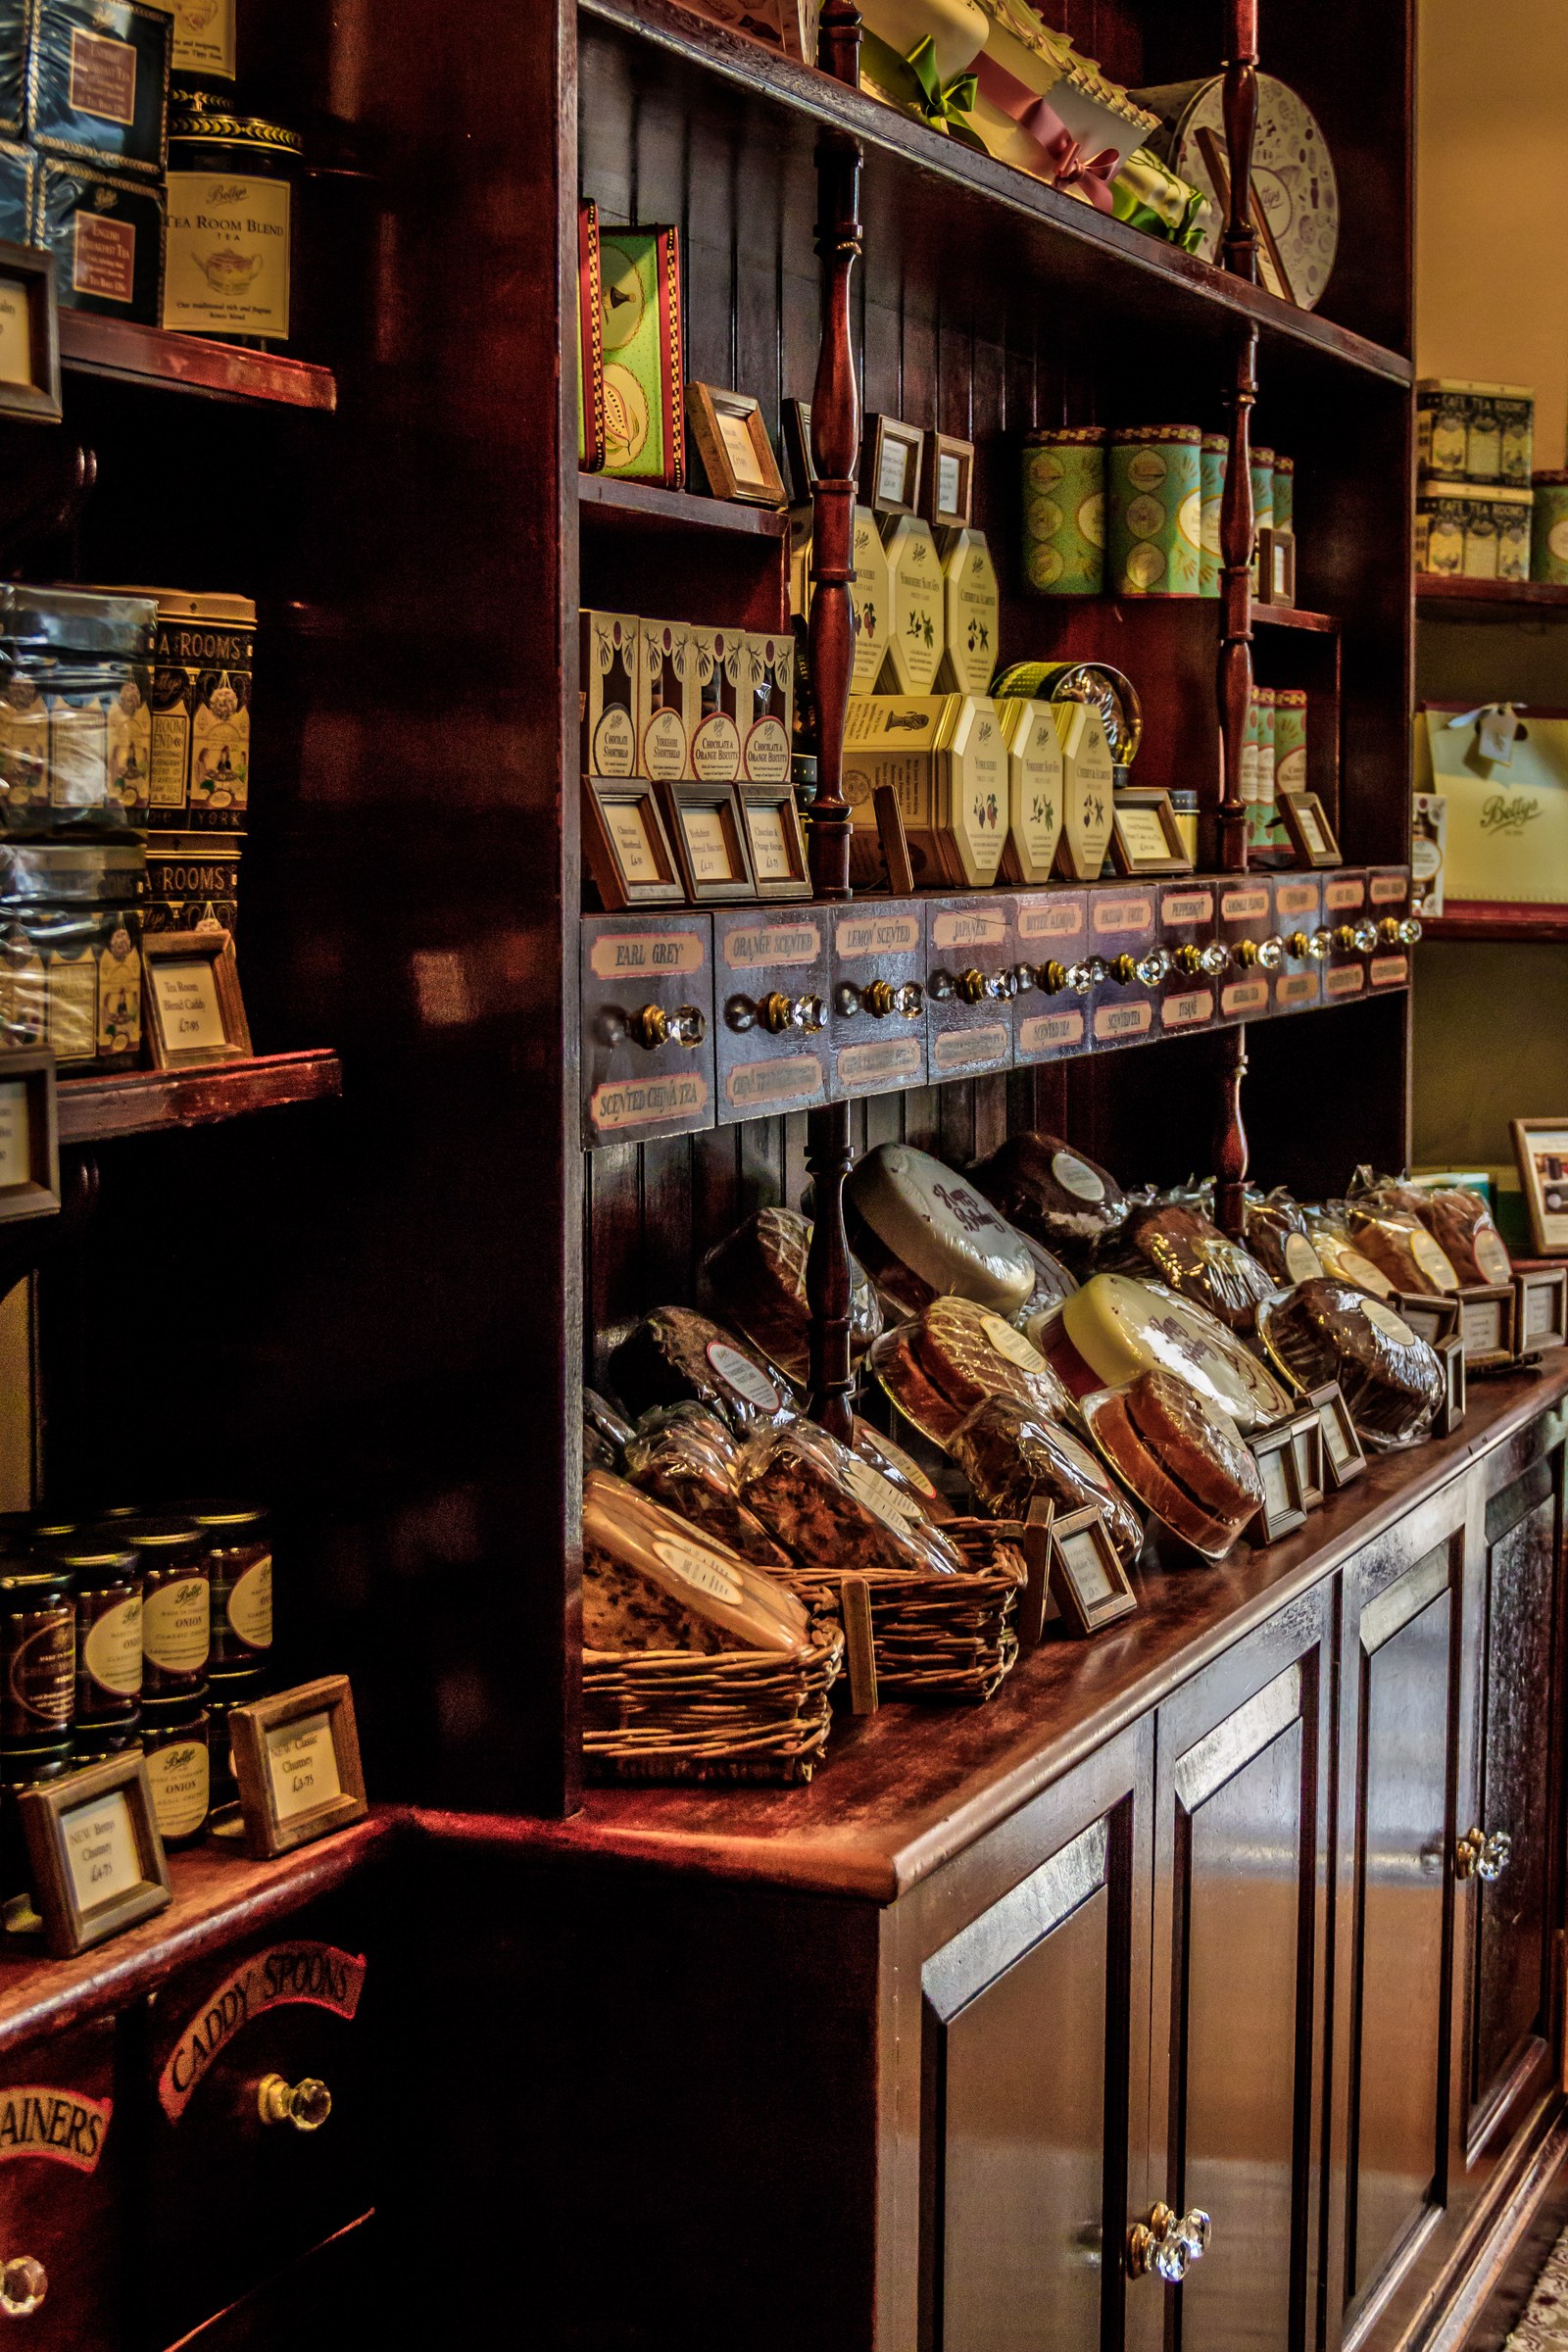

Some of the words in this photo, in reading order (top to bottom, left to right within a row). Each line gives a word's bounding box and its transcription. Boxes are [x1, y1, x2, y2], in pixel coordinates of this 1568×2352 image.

[166, 215, 191, 229] TEA
[197, 215, 242, 231] ROOM
[247, 219, 284, 237] BLEND
[218, 232, 241, 242] TEA
[180, 632, 241, 660] ROOMS
[702, 737, 729, 749] CHOCOLATE
[754, 740, 779, 752] CHOCOLATE
[695, 750, 716, 760] ORANGE
[717, 750, 739, 760] BISCUITS
[748, 751, 767, 762] ORANGE
[768, 753, 788, 762] BISCUITS
[163, 866, 225, 891] ROOMS
[847, 921, 876, 951] LEMON
[877, 919, 910, 948] SCENTED
[953, 918, 987, 942] JAPANESE
[615, 945, 646, 966] EARL
[652, 943, 684, 965] GREY
[166, 982, 177, 995] Tea
[178, 981, 199, 994] Room
[164, 998, 185, 1011] Blend
[185, 997, 206, 1012] Caddy
[600, 1087, 646, 1121] SCENTED
[272, 1742, 292, 1758] NEW
[295, 1734, 318, 1750] Classic
[282, 1755, 314, 1774] Chutney
[167, 1781, 197, 1795] ONION
[70, 1830, 91, 1844] NEW
[171, 1971, 253, 2092] CADDY
[262, 1953, 348, 2002] SPOONS
[0, 2099, 102, 2158] AINERS
